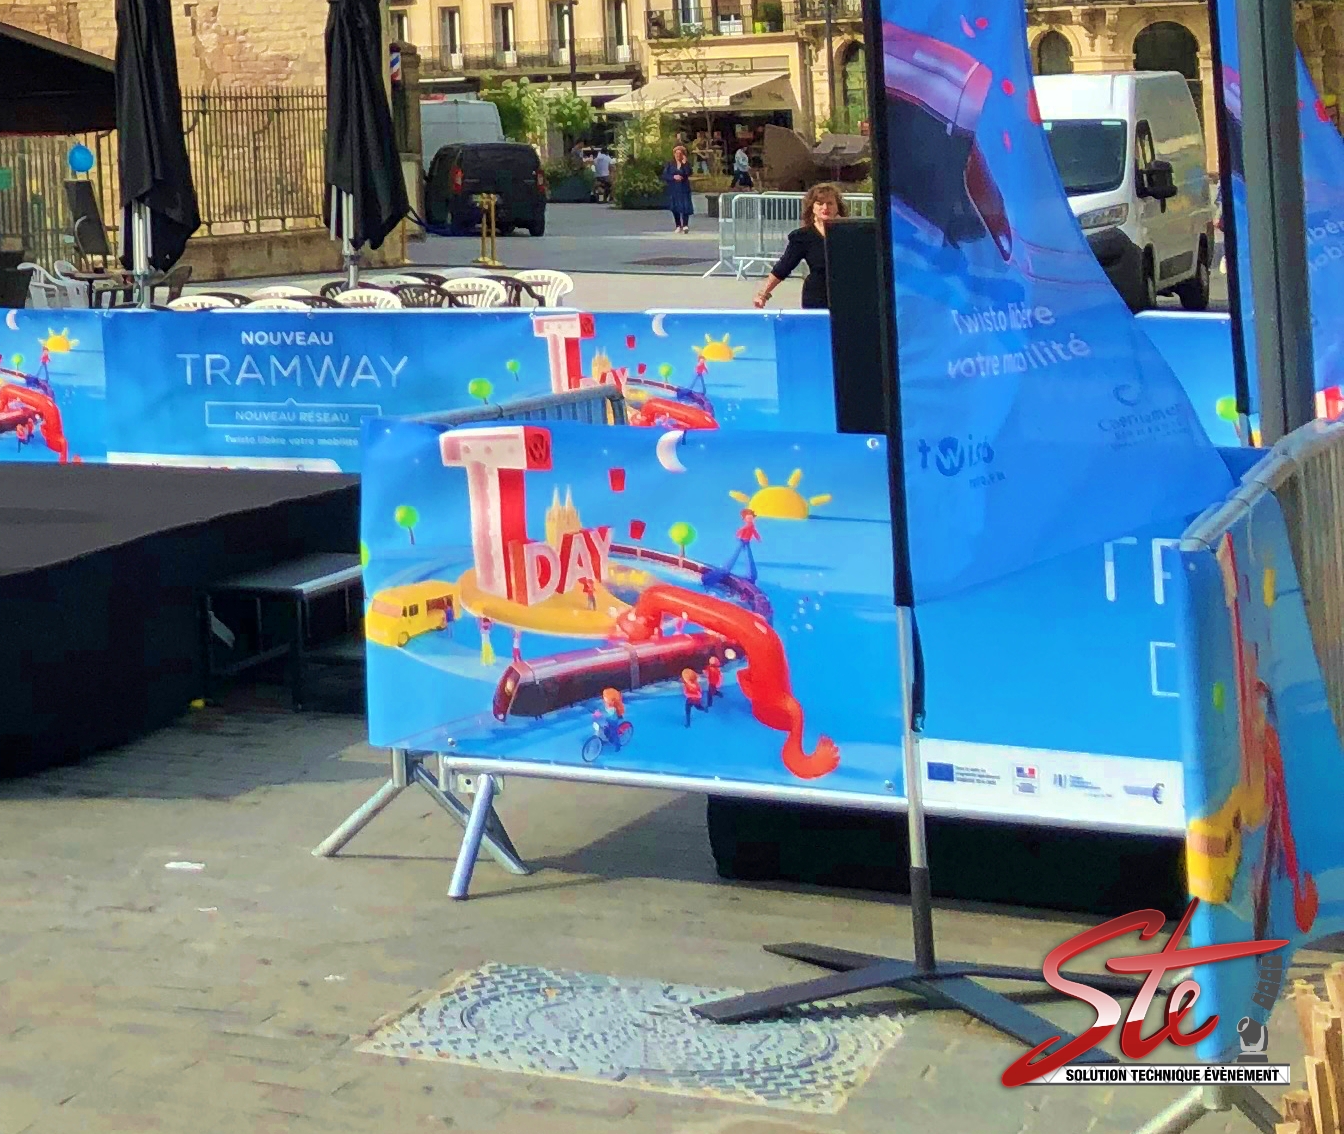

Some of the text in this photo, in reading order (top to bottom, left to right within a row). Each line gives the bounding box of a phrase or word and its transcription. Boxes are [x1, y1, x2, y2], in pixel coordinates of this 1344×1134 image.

[240, 330, 334, 346] NOUVEAU
[175, 353, 409, 388] TRAMWAY
[235, 410, 350, 423] NOUVEAU RÉSEAU
[288, 437, 314, 446] votre
[508, 526, 615, 607] DAY
